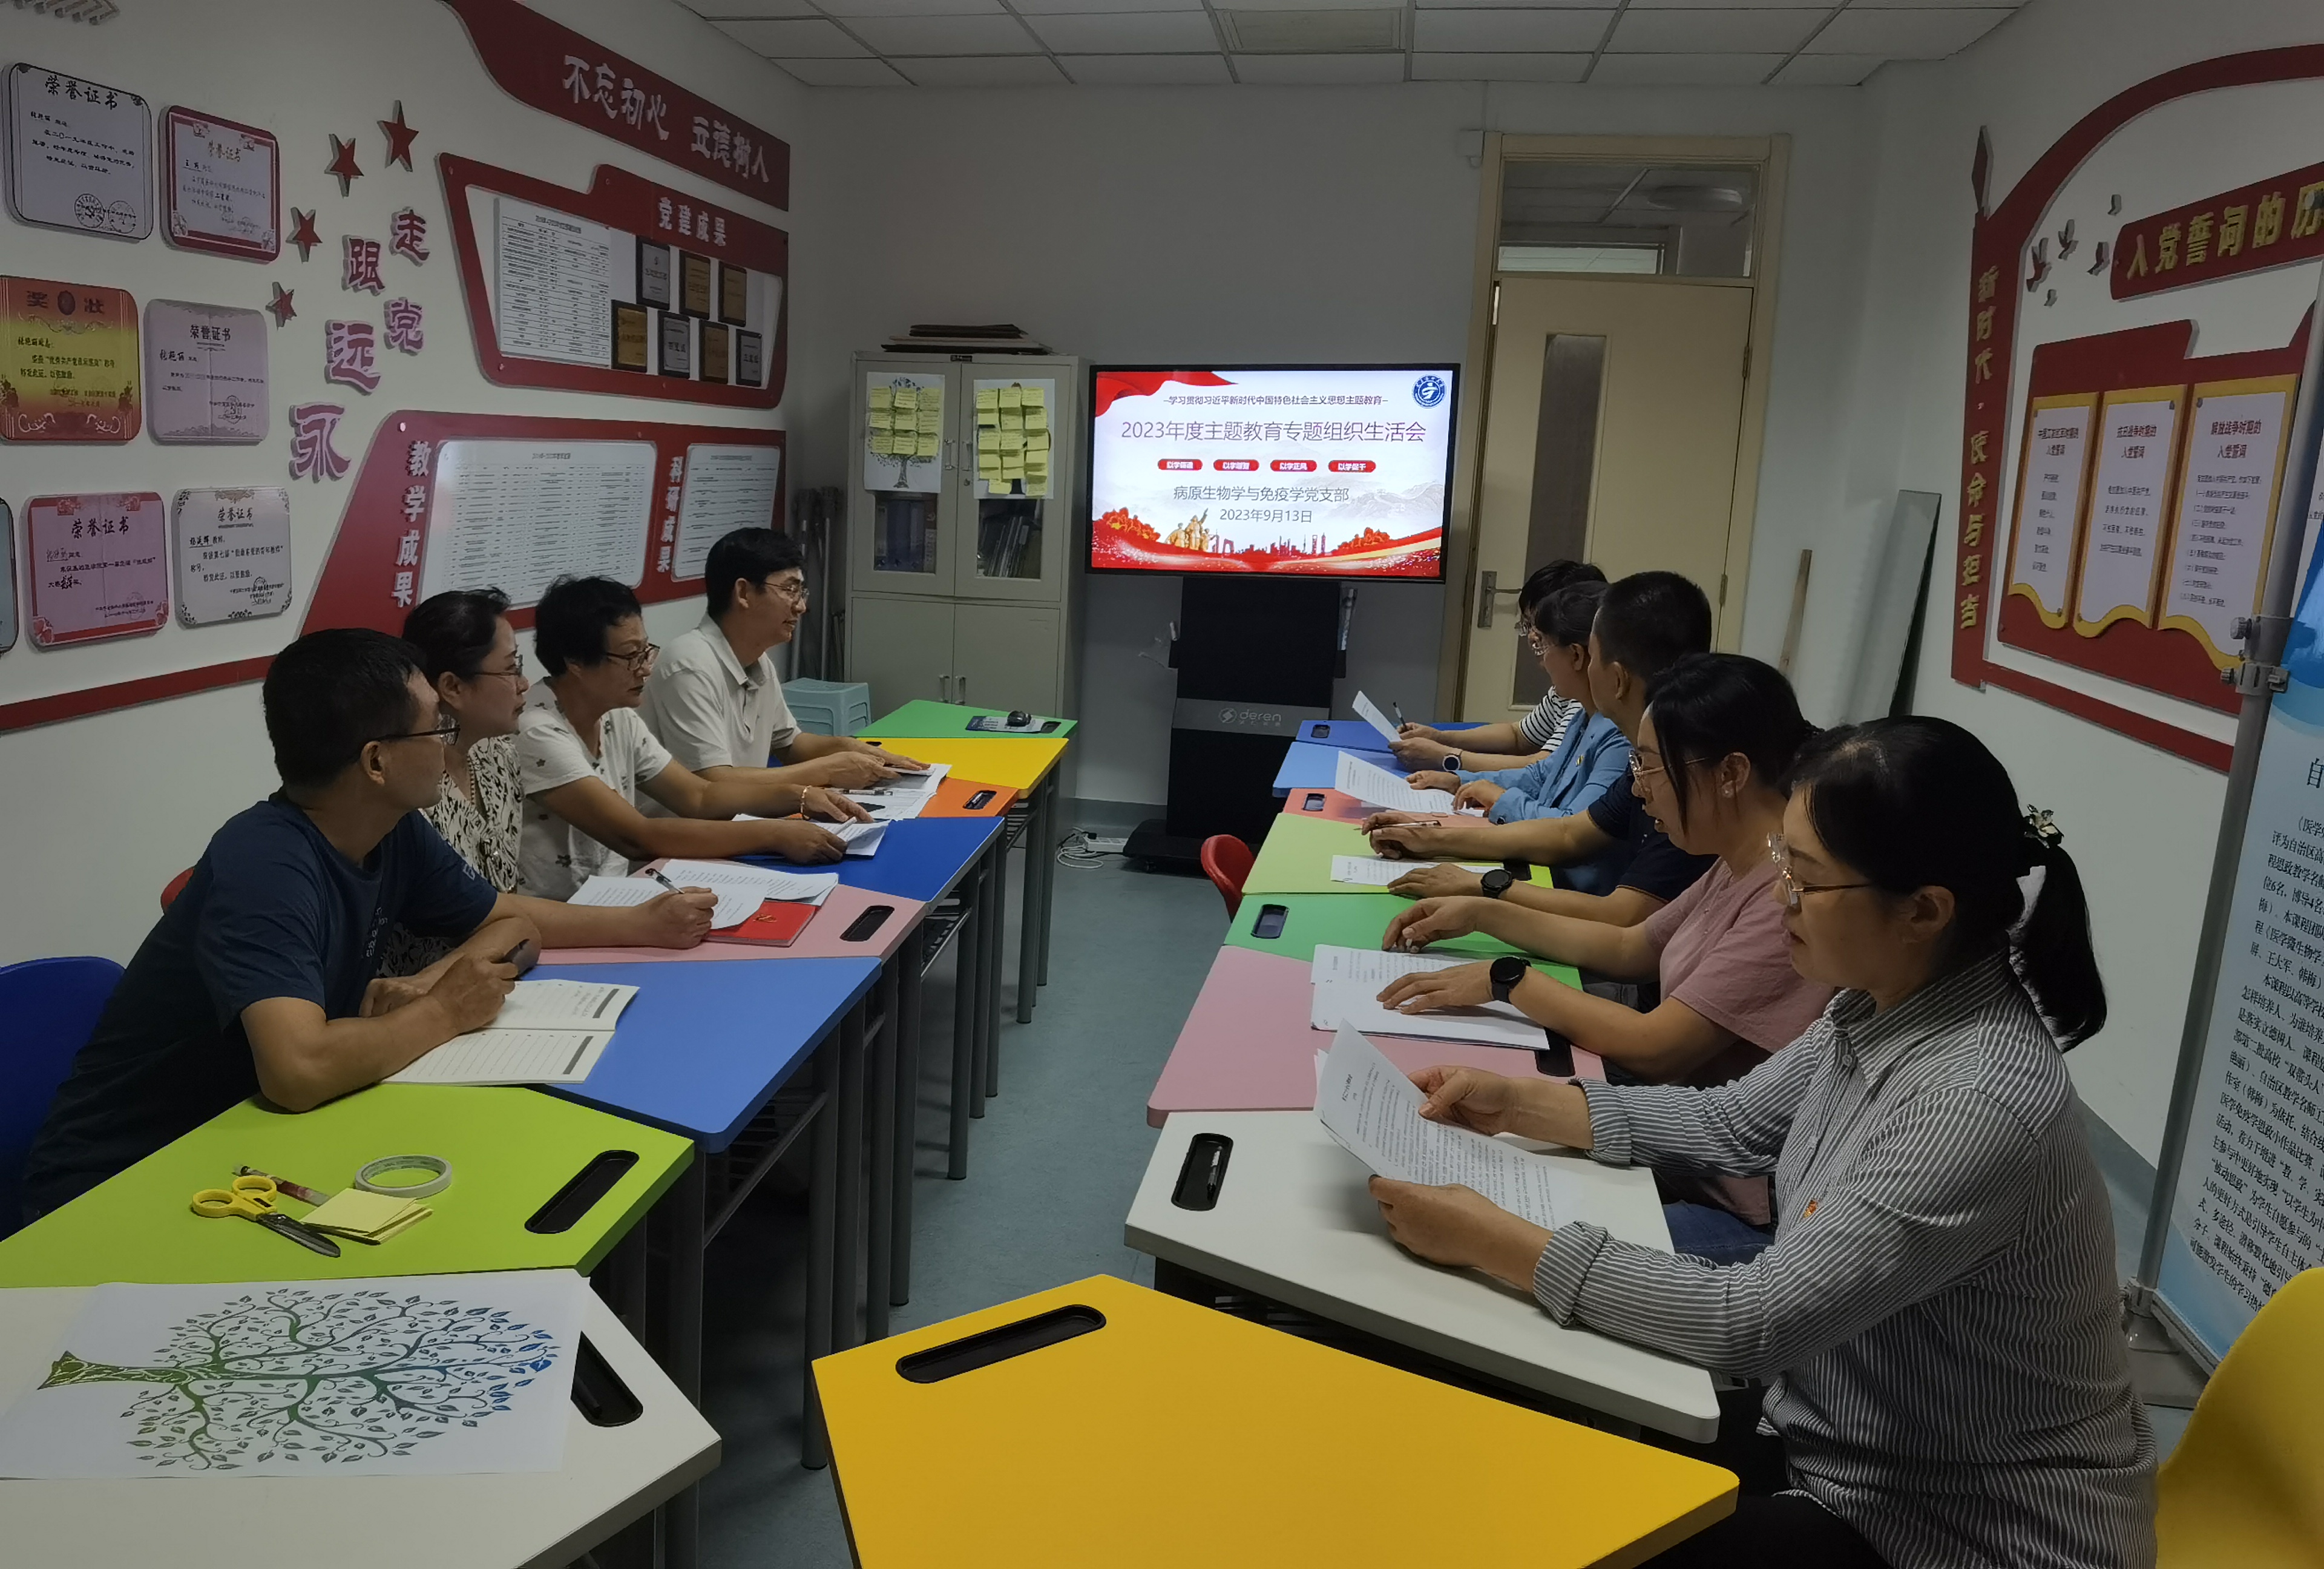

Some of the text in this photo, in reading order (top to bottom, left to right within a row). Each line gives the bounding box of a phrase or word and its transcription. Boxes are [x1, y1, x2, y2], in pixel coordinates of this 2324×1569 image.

[45, 75, 118, 110] 荣誉证书
[563, 54, 769, 183] 不忘初心 立德树人
[658, 197, 727, 247] 党建成果
[190, 324, 231, 341] 荣誉证书
[1121, 421, 1426, 443] 2023年度主题教育专题组织生活会
[1174, 486, 1350, 502] 病原生物学与免疫学党支部
[72, 516, 130, 539] 荣誉证书
[393, 441, 432, 608] 教学成果
[1219, 509, 1312, 523] 2023年9月13日
[1239, 709, 1281, 722] deren
[2306, 758, 2324, 789] 自
